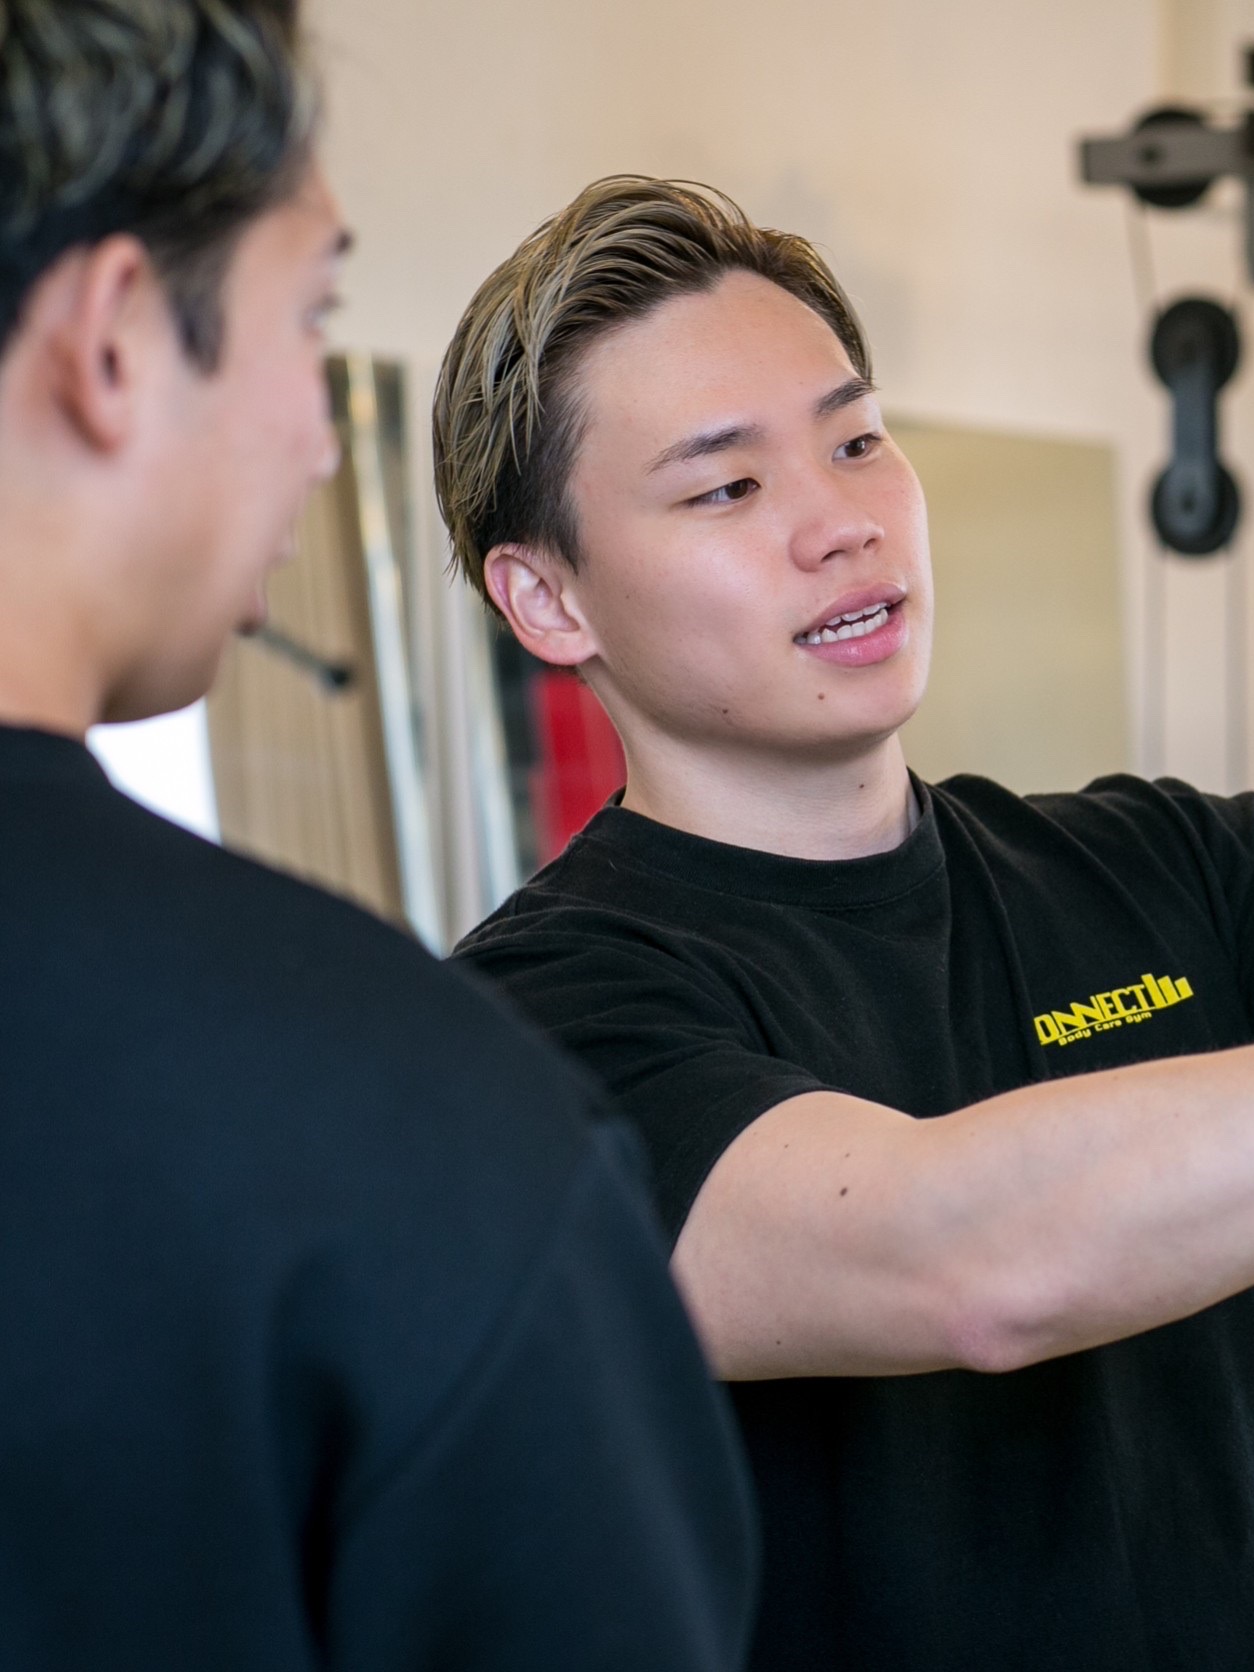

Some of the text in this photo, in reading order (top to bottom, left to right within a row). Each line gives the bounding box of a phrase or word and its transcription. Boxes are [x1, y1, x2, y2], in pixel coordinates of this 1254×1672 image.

[1033, 983, 1150, 1046] ONNECT
[1058, 1010, 1153, 1047] Body Care Gym
